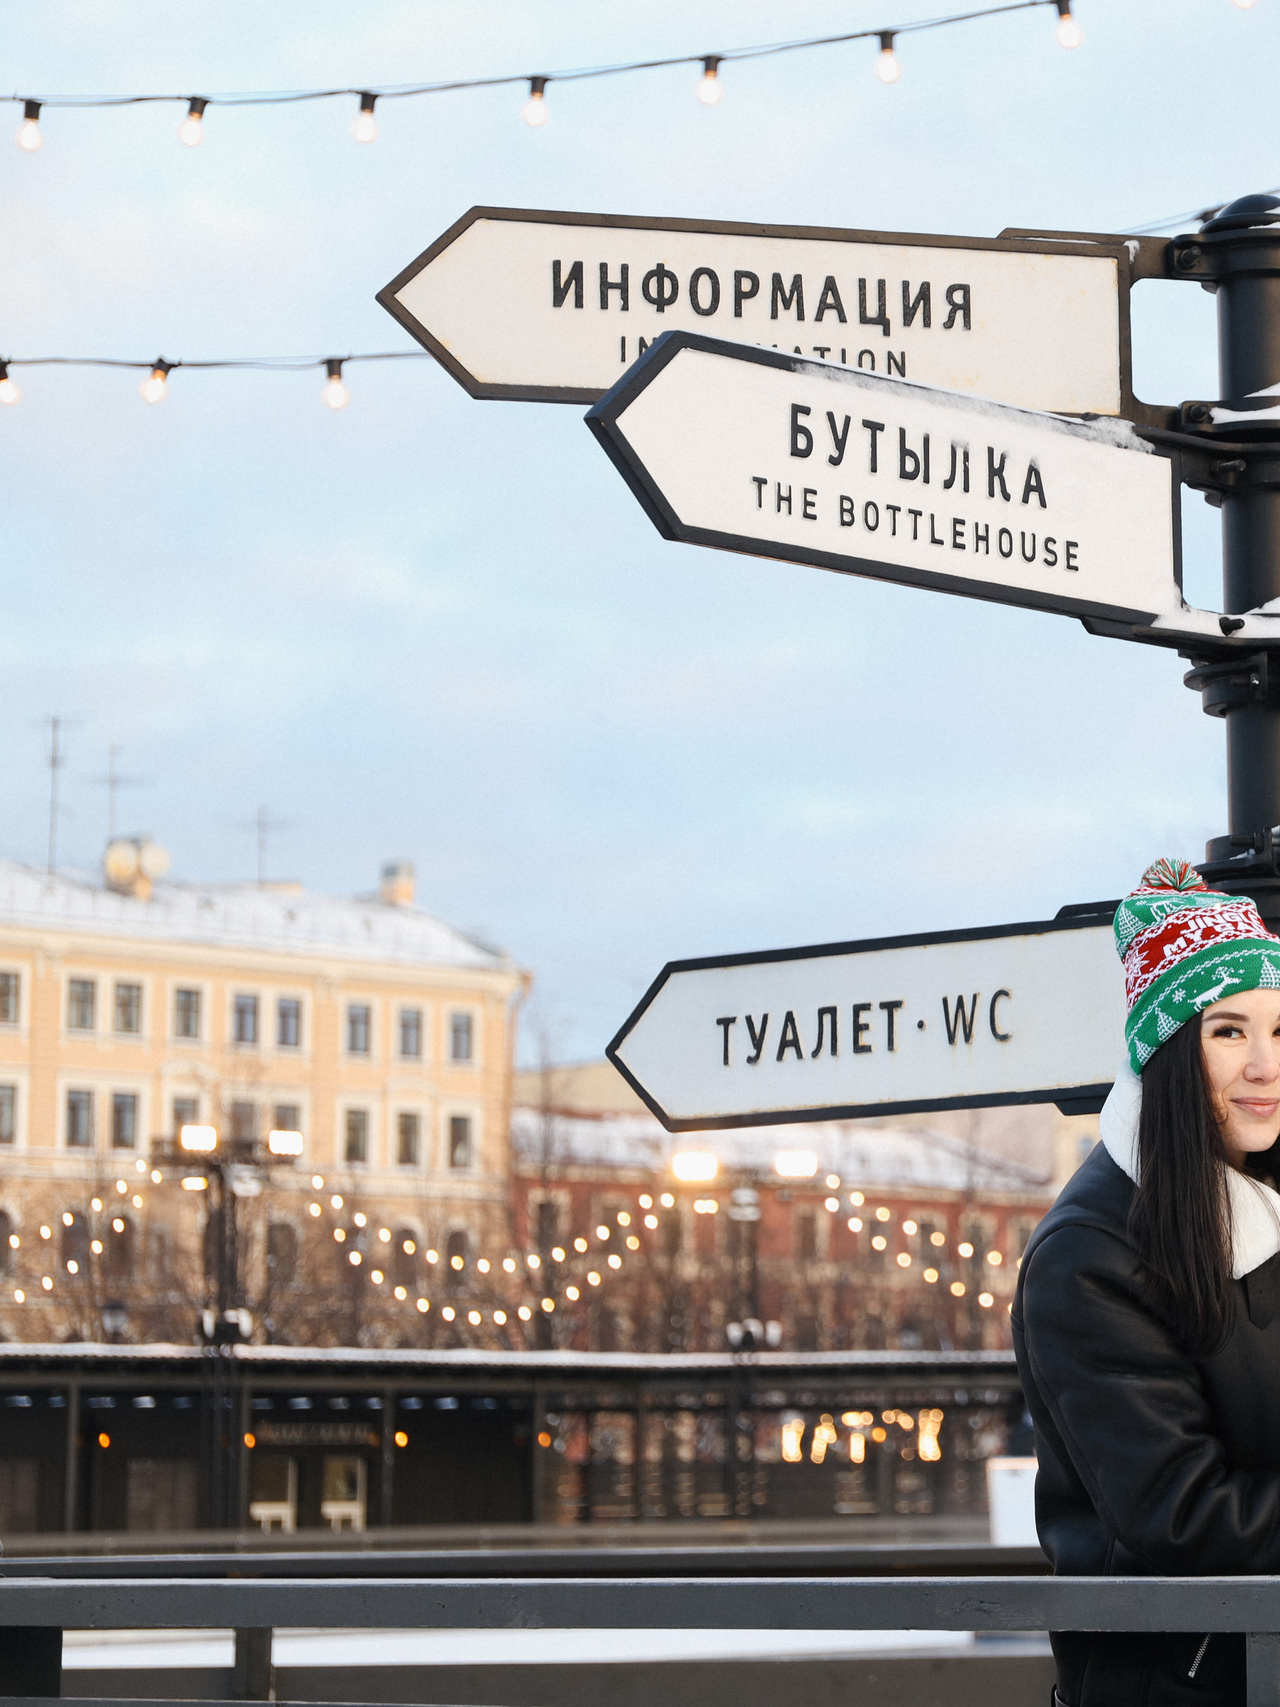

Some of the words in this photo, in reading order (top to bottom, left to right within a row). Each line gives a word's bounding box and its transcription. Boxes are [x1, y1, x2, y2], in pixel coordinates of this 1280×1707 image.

[552, 259, 972, 335] ИНФОРМАЦИЯ
[790, 402, 1048, 509] БУТЫЛКА
[752, 475, 818, 521] THE
[839, 493, 1080, 572] BOTTLEHOUSE
[716, 1000, 904, 1066] ТУАЛЕТ
[941, 988, 1013, 1046] WC
